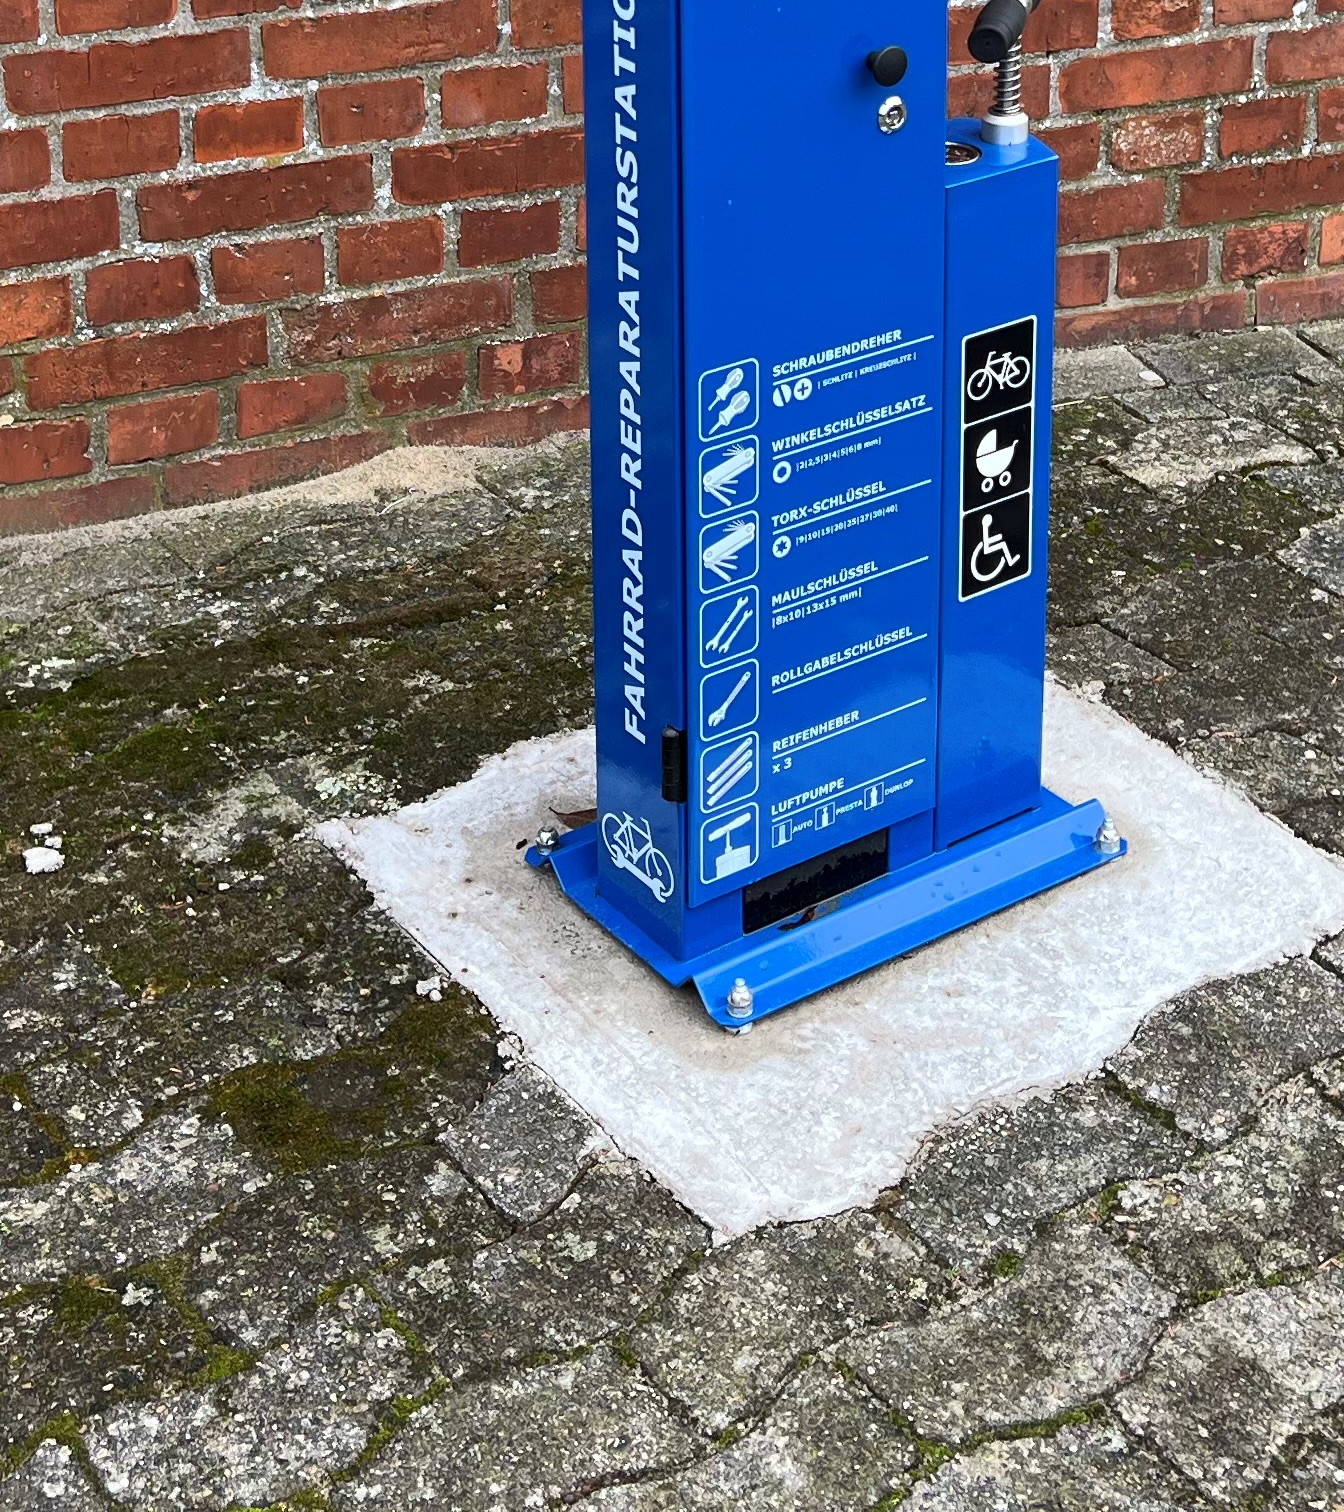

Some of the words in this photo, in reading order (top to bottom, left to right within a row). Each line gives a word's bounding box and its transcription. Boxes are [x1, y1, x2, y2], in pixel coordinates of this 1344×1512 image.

[772, 329, 902, 377] SCHRAUBENDREHER
[771, 394, 926, 453] WINKELSCHLÜSSELSATZ
[771, 481, 886, 528] TORX-SCHLÜSSEL
[771, 561, 878, 607] MAULSCHLÜSSEL
[771, 626, 913, 687] ROLLGABELSCHLÜSSEL
[772, 710, 860, 753] REIFENHEBER
[772, 763, 781, 774] x
[784, 757, 792, 770] 3
[884, 778, 914, 796] DUNLOP
[771, 777, 845, 816] LUFTPUMPE
[836, 800, 863, 815] PRESTA
[792, 819, 813, 834] AUTO
